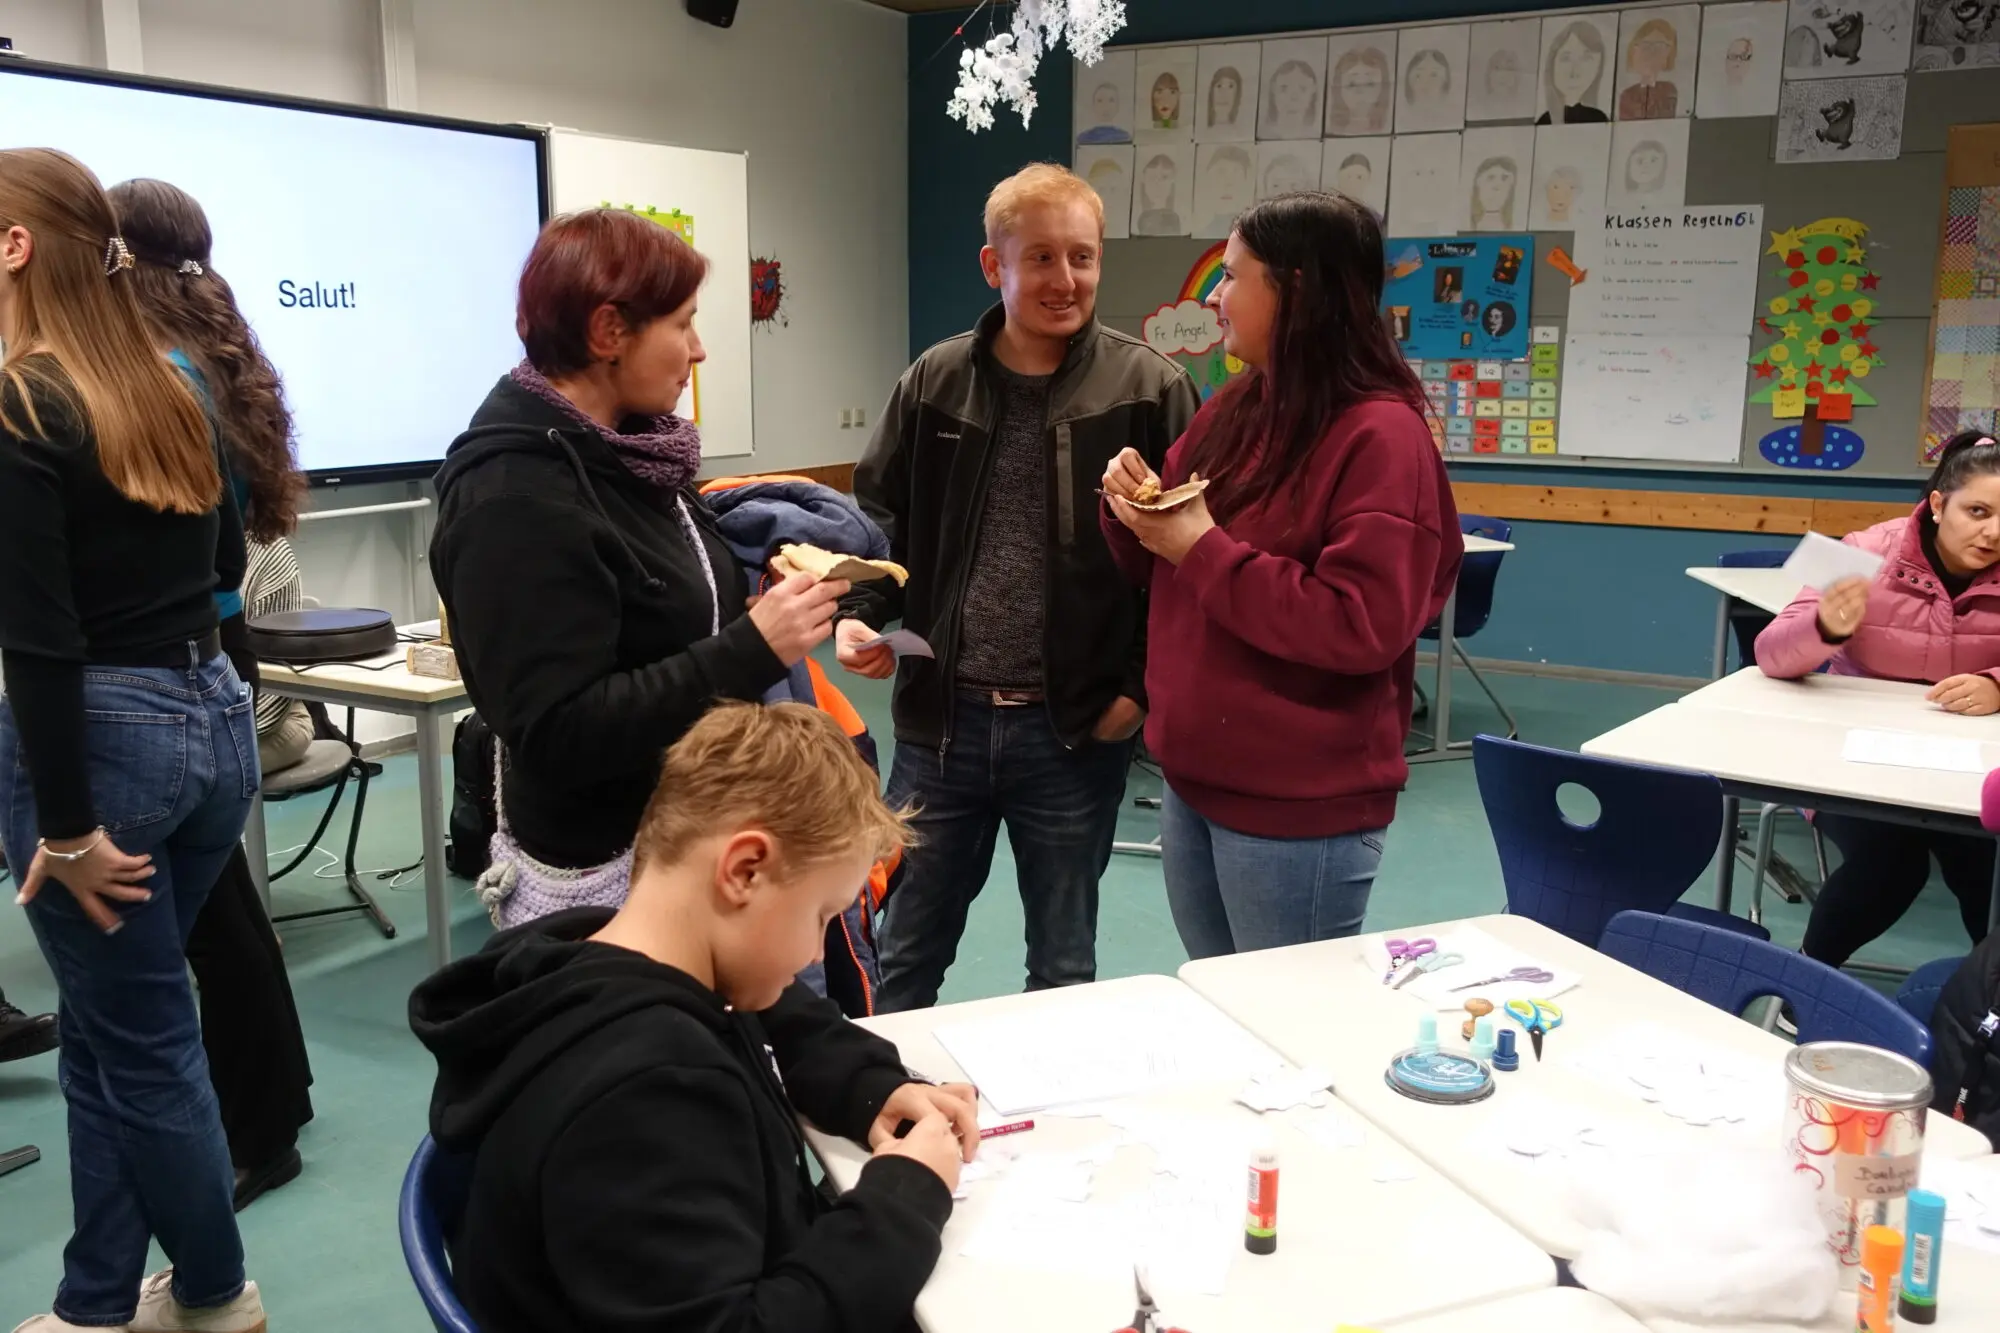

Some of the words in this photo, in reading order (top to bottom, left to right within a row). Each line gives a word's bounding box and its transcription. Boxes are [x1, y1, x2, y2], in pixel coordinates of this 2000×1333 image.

[1605, 214, 1672, 229] Klassen
[1683, 214, 1733, 228] Regeln
[278, 279, 356, 308] Salut!
[1173, 321, 1208, 343] Angel
